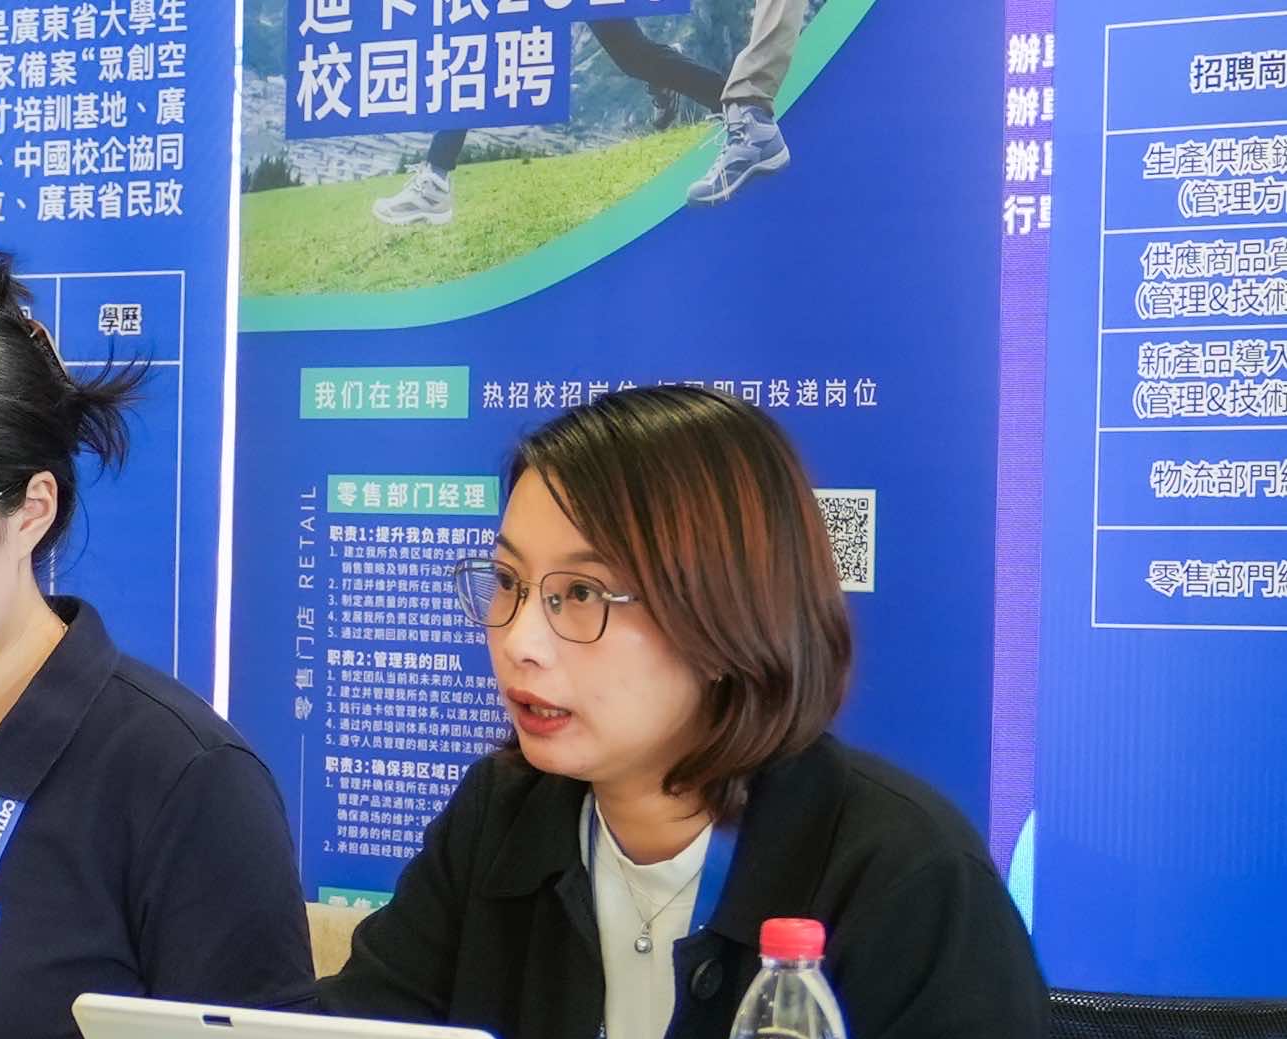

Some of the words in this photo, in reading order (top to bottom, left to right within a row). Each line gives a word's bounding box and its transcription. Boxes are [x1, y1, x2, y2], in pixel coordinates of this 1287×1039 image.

[296, 25, 556, 122] 校园招聘
[1192, 50, 1287, 92] 招聘崗
[1179, 178, 1287, 217] (管理方
[98, 303, 142, 335] 學歷
[314, 380, 450, 410] 我们在招聘
[337, 481, 485, 508] 零售部门经理
[298, 487, 316, 588] RETAIL
[329, 525, 498, 545] 职责1:提升我负责部门的
[328, 579, 338, 589] 2.
[342, 578, 458, 593] 打造并维护我所在商场
[328, 595, 338, 606] 3.
[328, 611, 337, 622] 4.
[328, 627, 337, 638] 5.
[294, 606, 316, 720] 零售门店
[327, 649, 462, 671] 职责2:管理我的团队
[326, 686, 335, 697] 2.
[326, 702, 335, 713] 3.
[326, 718, 335, 729] 4.
[340, 718, 511, 739] 通过内部培训体系培养团队成员的
[326, 734, 335, 745] 5.
[340, 776, 456, 797] 管理并确保我所在商场
[338, 793, 448, 812] 管理产品流通情况:收
[338, 809, 434, 827] 确保商场的维护:
[323, 841, 334, 852] 2.
[338, 841, 423, 859] 承担值班经理的
